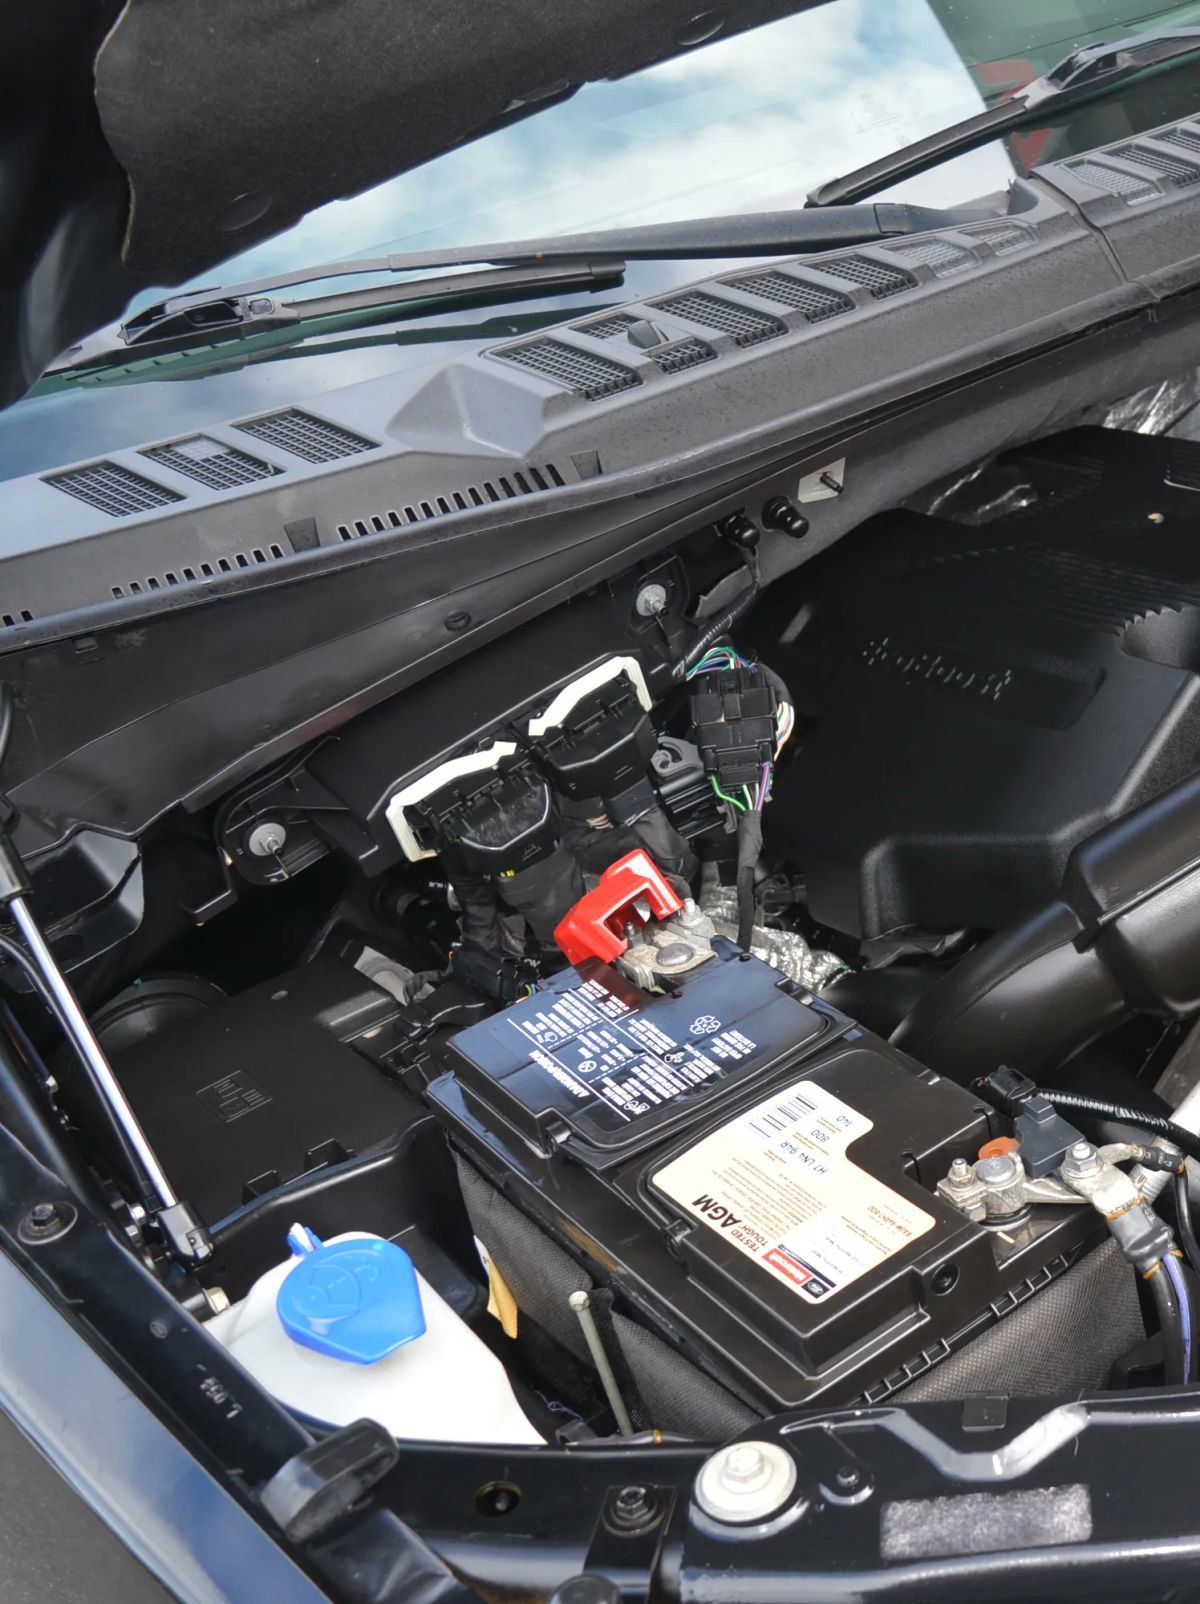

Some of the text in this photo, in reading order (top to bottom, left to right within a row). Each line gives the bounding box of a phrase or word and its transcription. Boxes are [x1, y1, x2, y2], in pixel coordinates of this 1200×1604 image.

[811, 1129, 830, 1143] 800
[692, 1194, 743, 1228] AGM
[730, 1229, 760, 1252] TESTED
